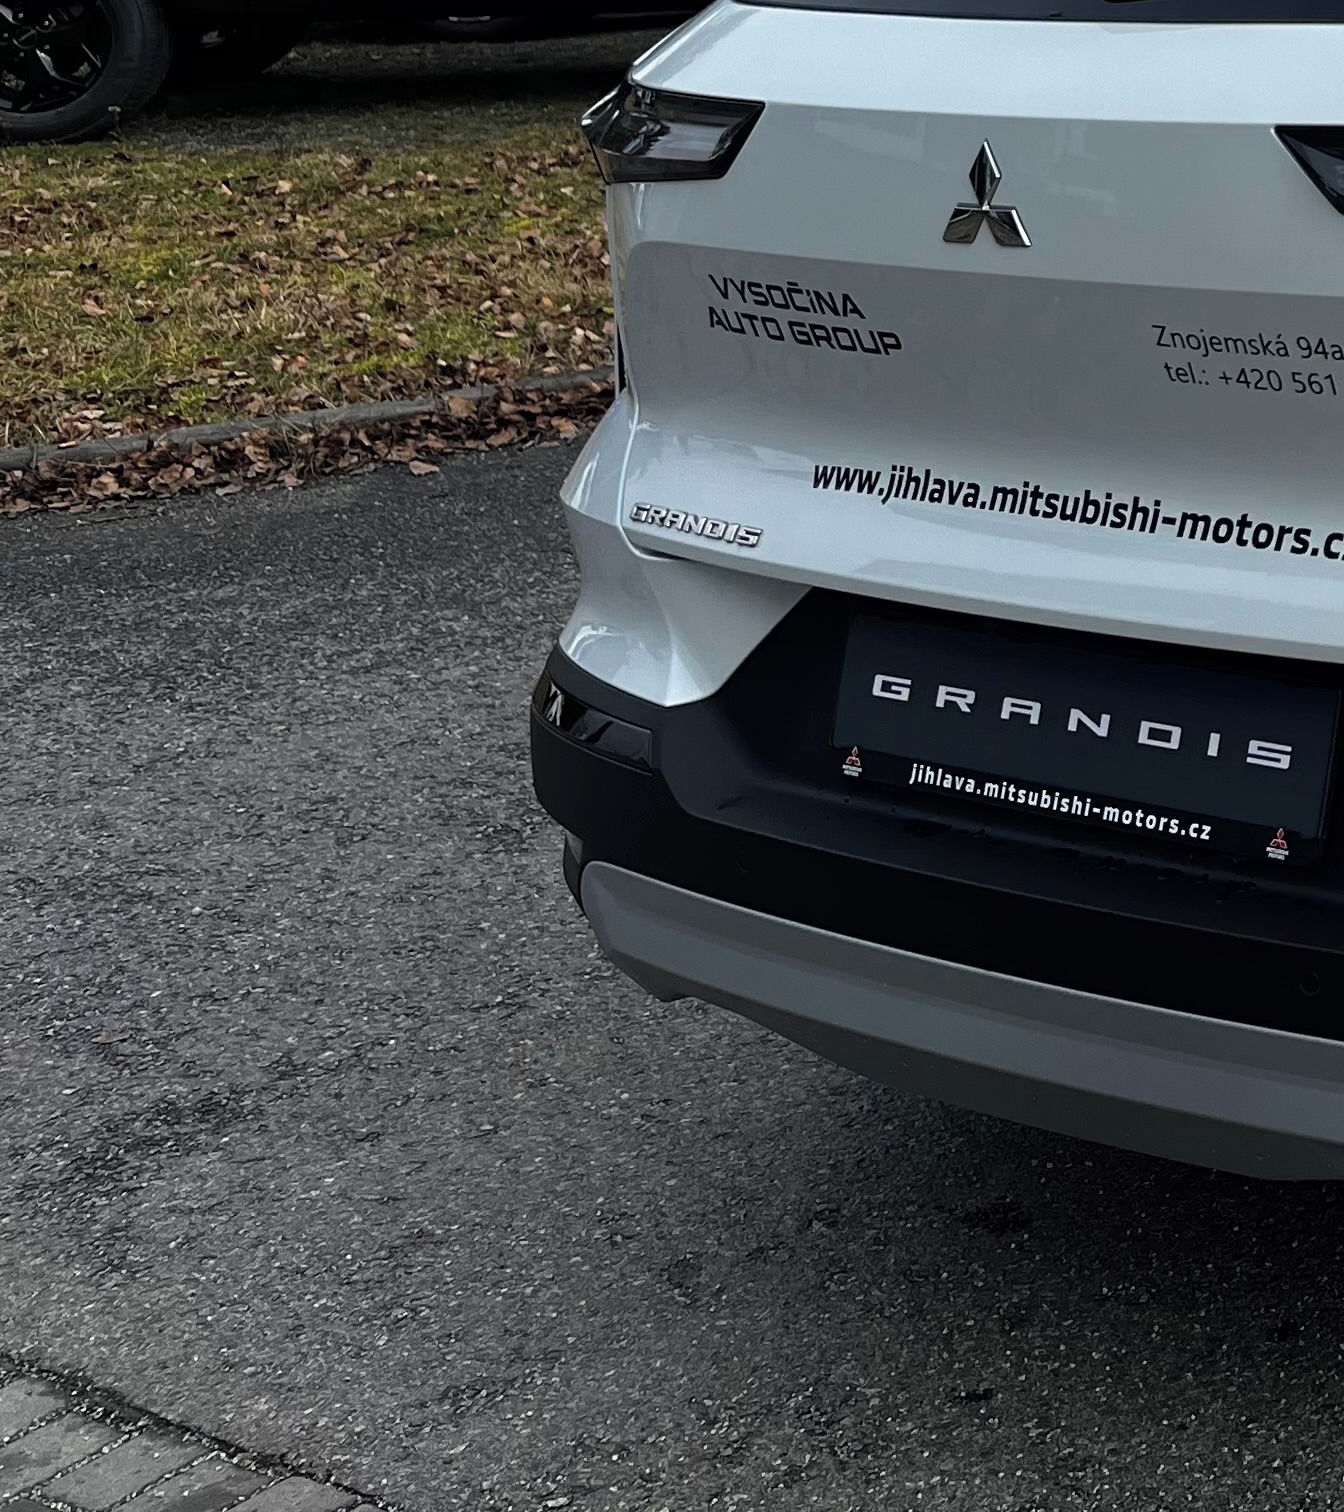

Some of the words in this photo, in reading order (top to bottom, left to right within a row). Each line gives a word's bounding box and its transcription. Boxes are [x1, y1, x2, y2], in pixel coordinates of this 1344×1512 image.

[708, 273, 866, 320] VYSOČINA
[708, 305, 785, 342] AUTO
[787, 319, 903, 356] GROUP
[1152, 324, 1290, 358] Znojemská
[1164, 361, 1210, 386] tel.:
[1219, 367, 1283, 392] +420
[1291, 371, 1337, 396] 561
[628, 502, 764, 549] GRANDIS
[871, 673, 1293, 771] GRANDIS
[908, 763, 1212, 842] jihlava.mitsubishi-motors.cz
